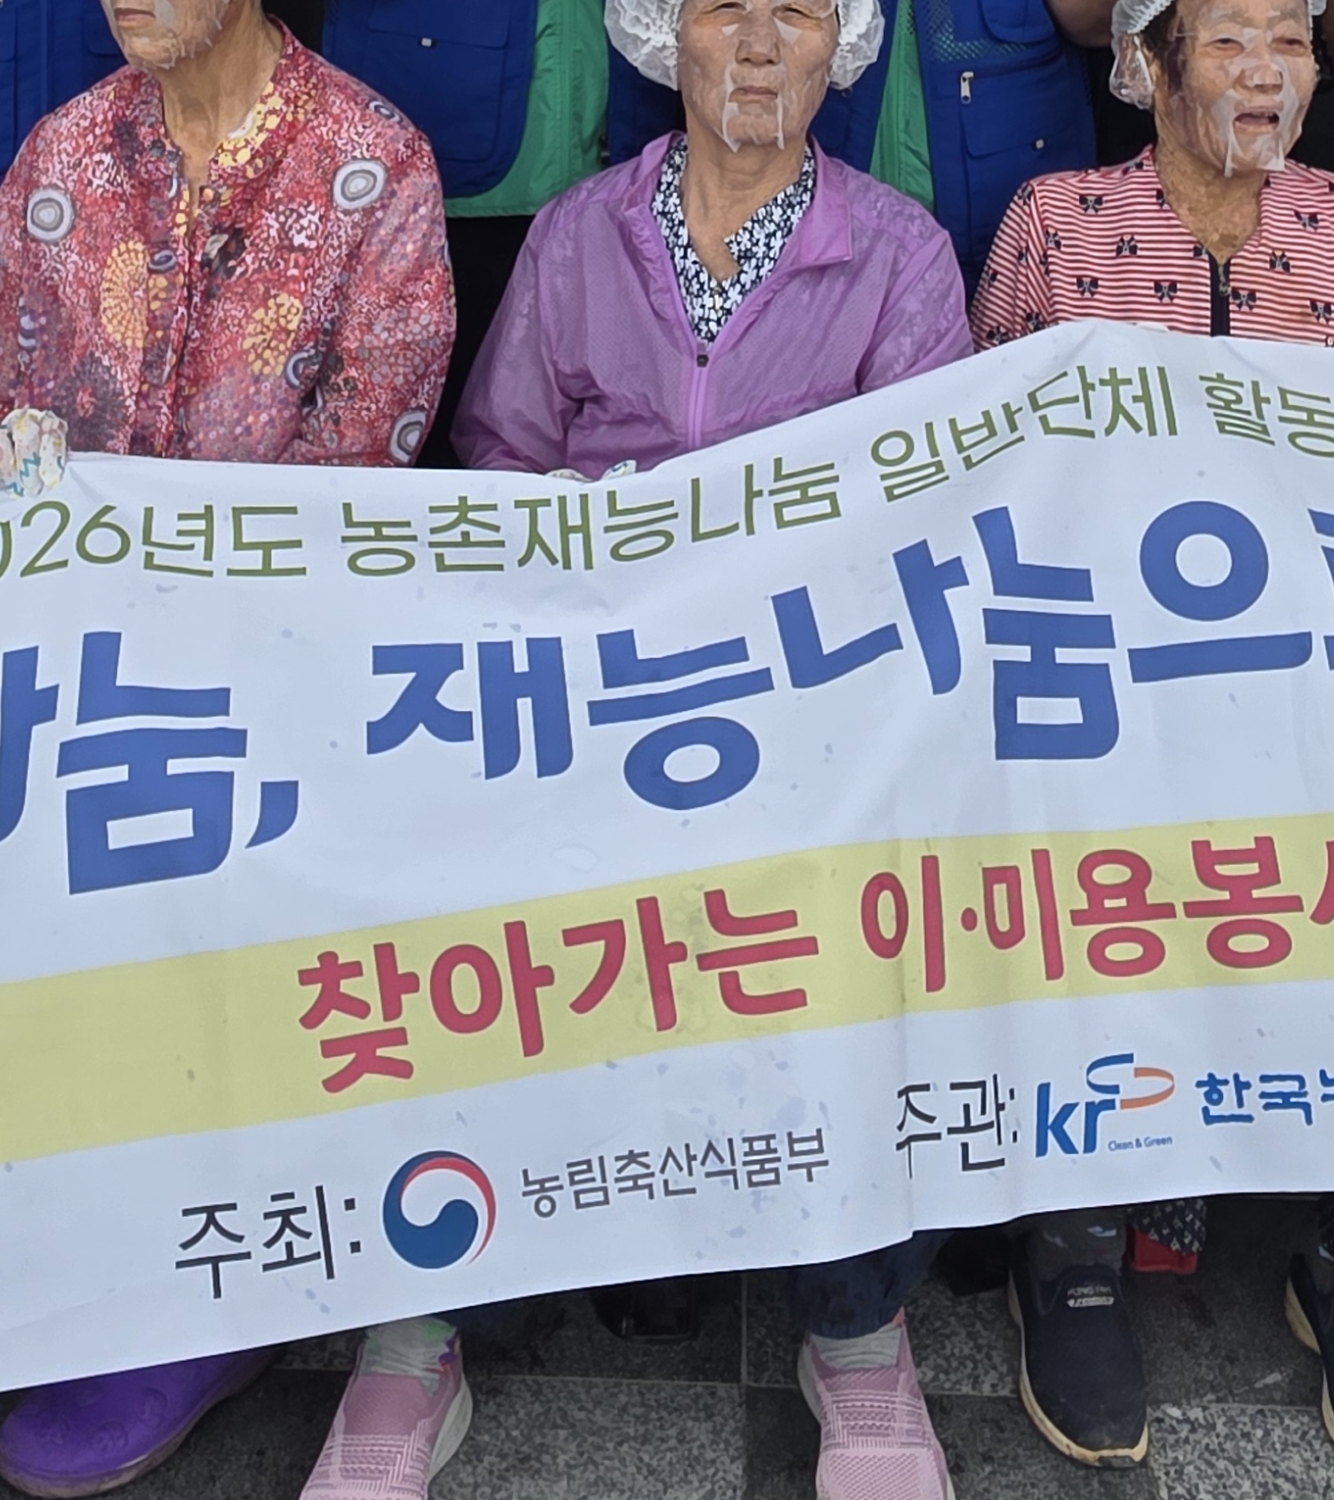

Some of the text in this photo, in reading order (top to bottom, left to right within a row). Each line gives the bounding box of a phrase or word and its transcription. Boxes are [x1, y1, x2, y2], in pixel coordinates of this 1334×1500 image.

[345, 459, 838, 574] 농촌재능나눔
[872, 368, 1174, 499] 일반단체
[301, 892, 816, 1092] 찾아가는
[896, 1074, 1017, 1177] 주관:
[1144, 1136, 1173, 1148] Green
[176, 1129, 828, 1298] 주최: 농림축산식품부
